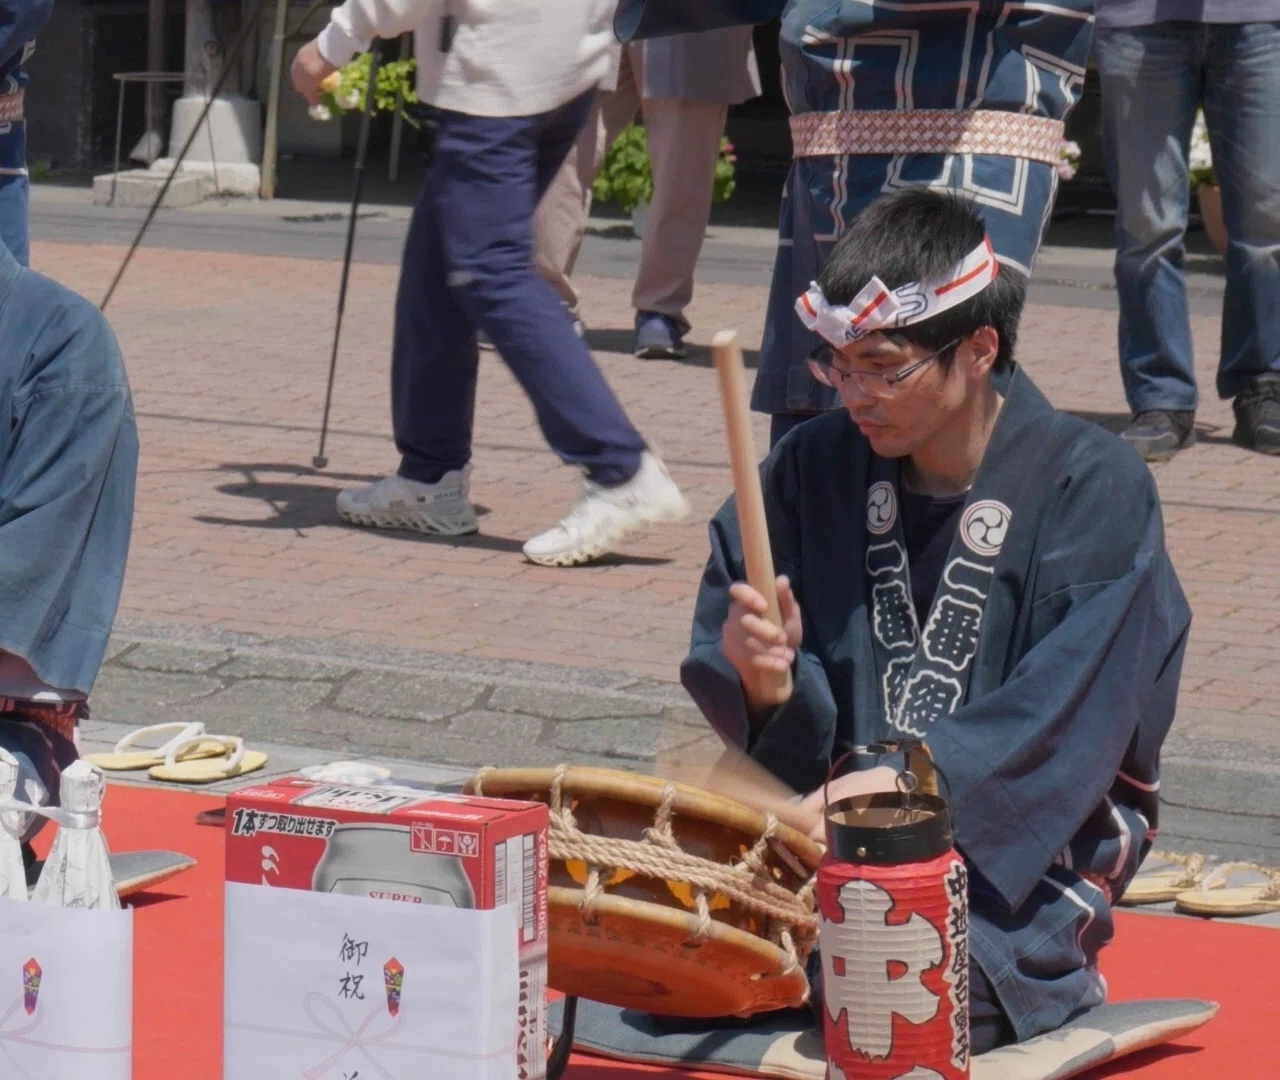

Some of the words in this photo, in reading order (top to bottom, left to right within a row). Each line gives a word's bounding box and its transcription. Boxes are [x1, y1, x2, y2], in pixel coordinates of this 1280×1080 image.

[895, 557, 994, 737] 一番組
[233, 808, 336, 837] 1本ずつ取り出せます
[338, 932, 369, 1001] 御祝
[820, 878, 945, 1080] 中
